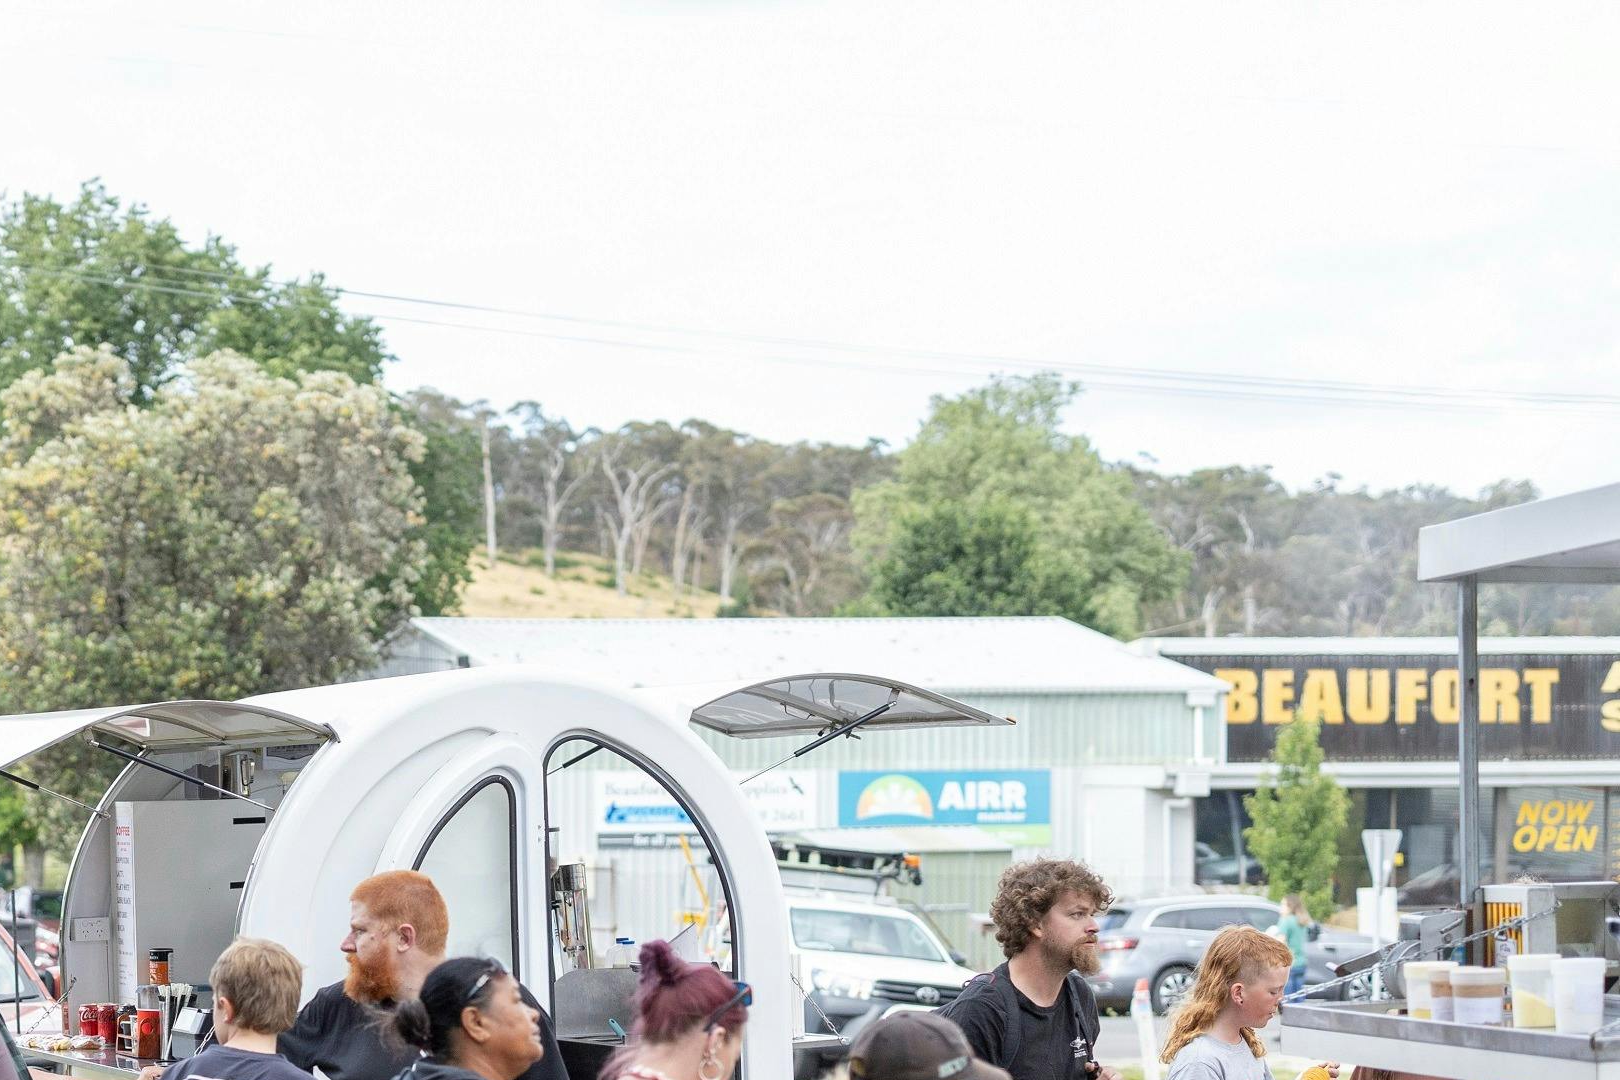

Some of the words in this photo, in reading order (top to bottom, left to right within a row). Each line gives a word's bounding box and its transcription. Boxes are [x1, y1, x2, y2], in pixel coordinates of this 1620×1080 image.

[1216, 667, 1560, 725] BEAUFORT
[937, 780, 1028, 811] AIRR
[1516, 800, 1595, 826] NOW
[1513, 825, 1598, 853] OPEN
